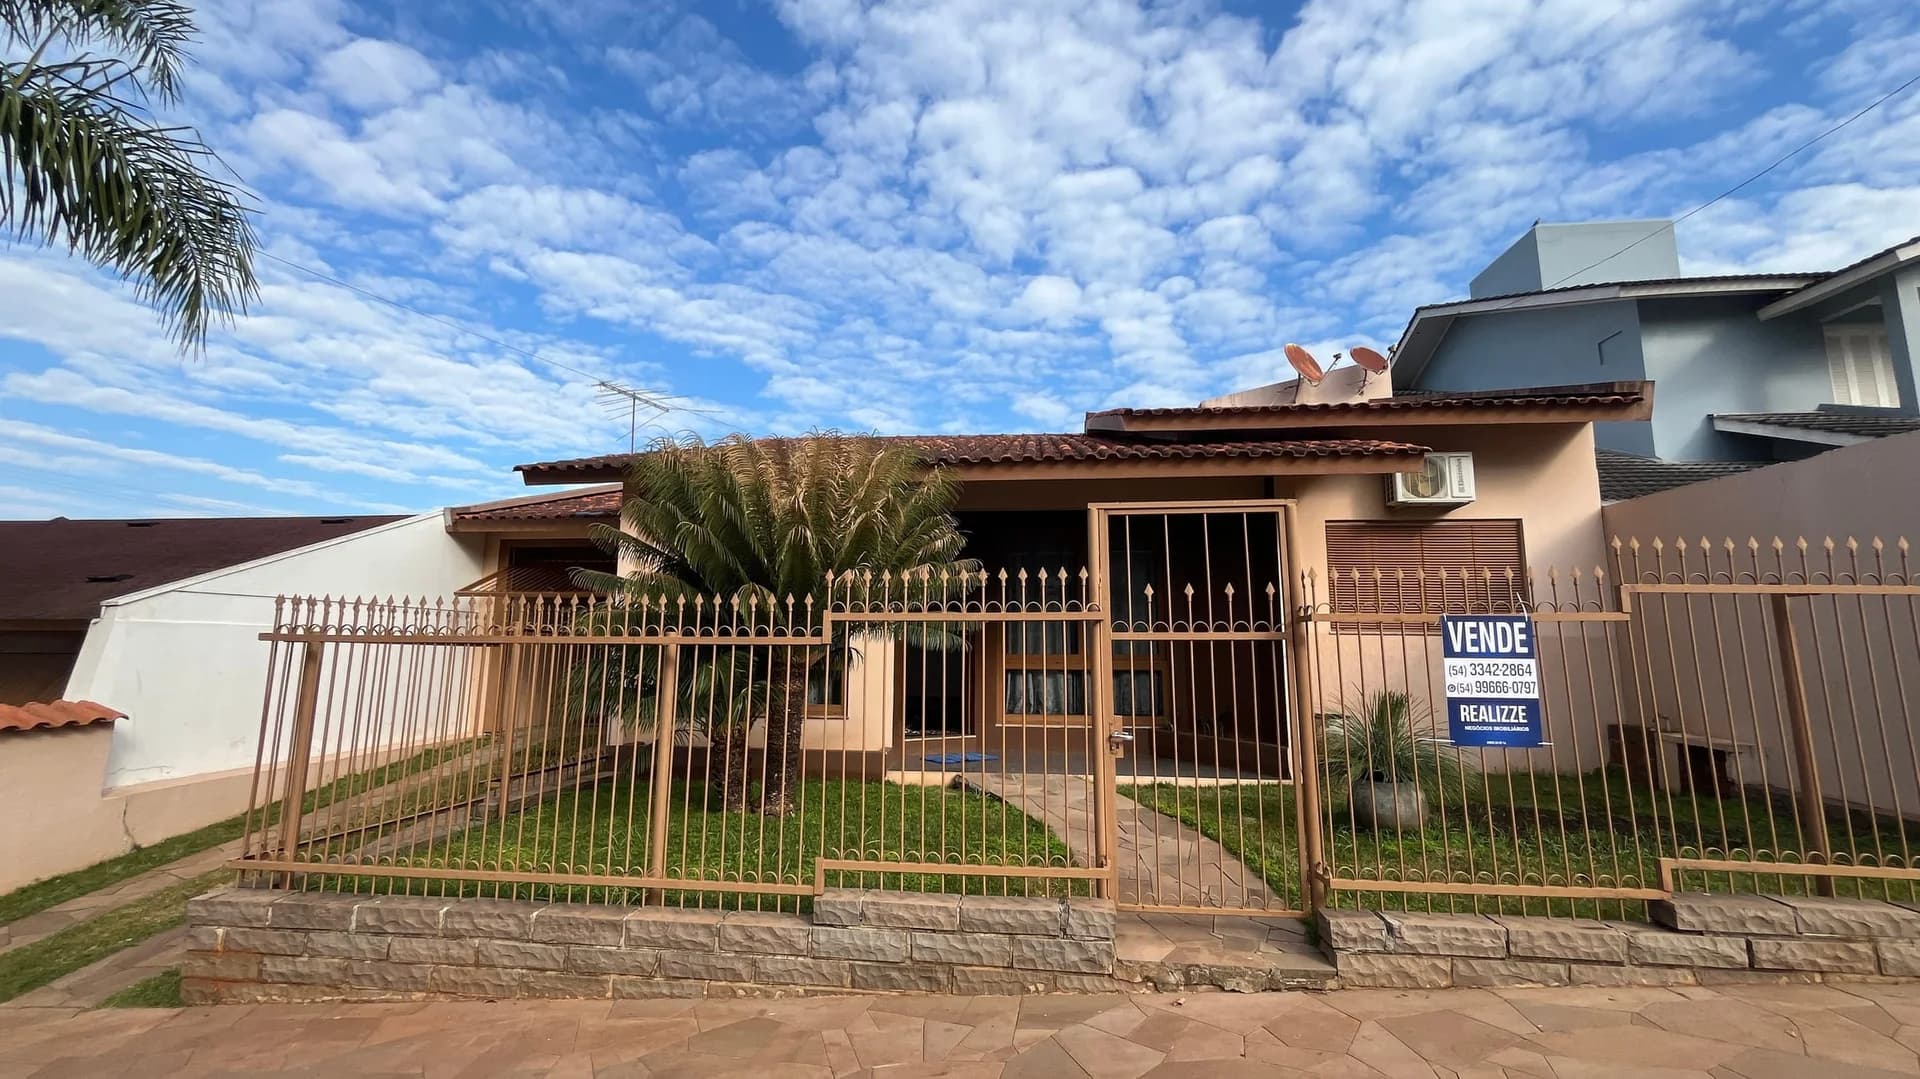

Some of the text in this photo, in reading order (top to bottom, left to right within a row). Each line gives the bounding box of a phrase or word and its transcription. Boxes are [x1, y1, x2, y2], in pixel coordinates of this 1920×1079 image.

[1447, 621, 1529, 654] VENDE
[1448, 663, 1532, 677] (54) 3342-2864
[1456, 681, 1536, 695] (54) 99666-0797
[1460, 704, 1528, 723] REALIZZE
